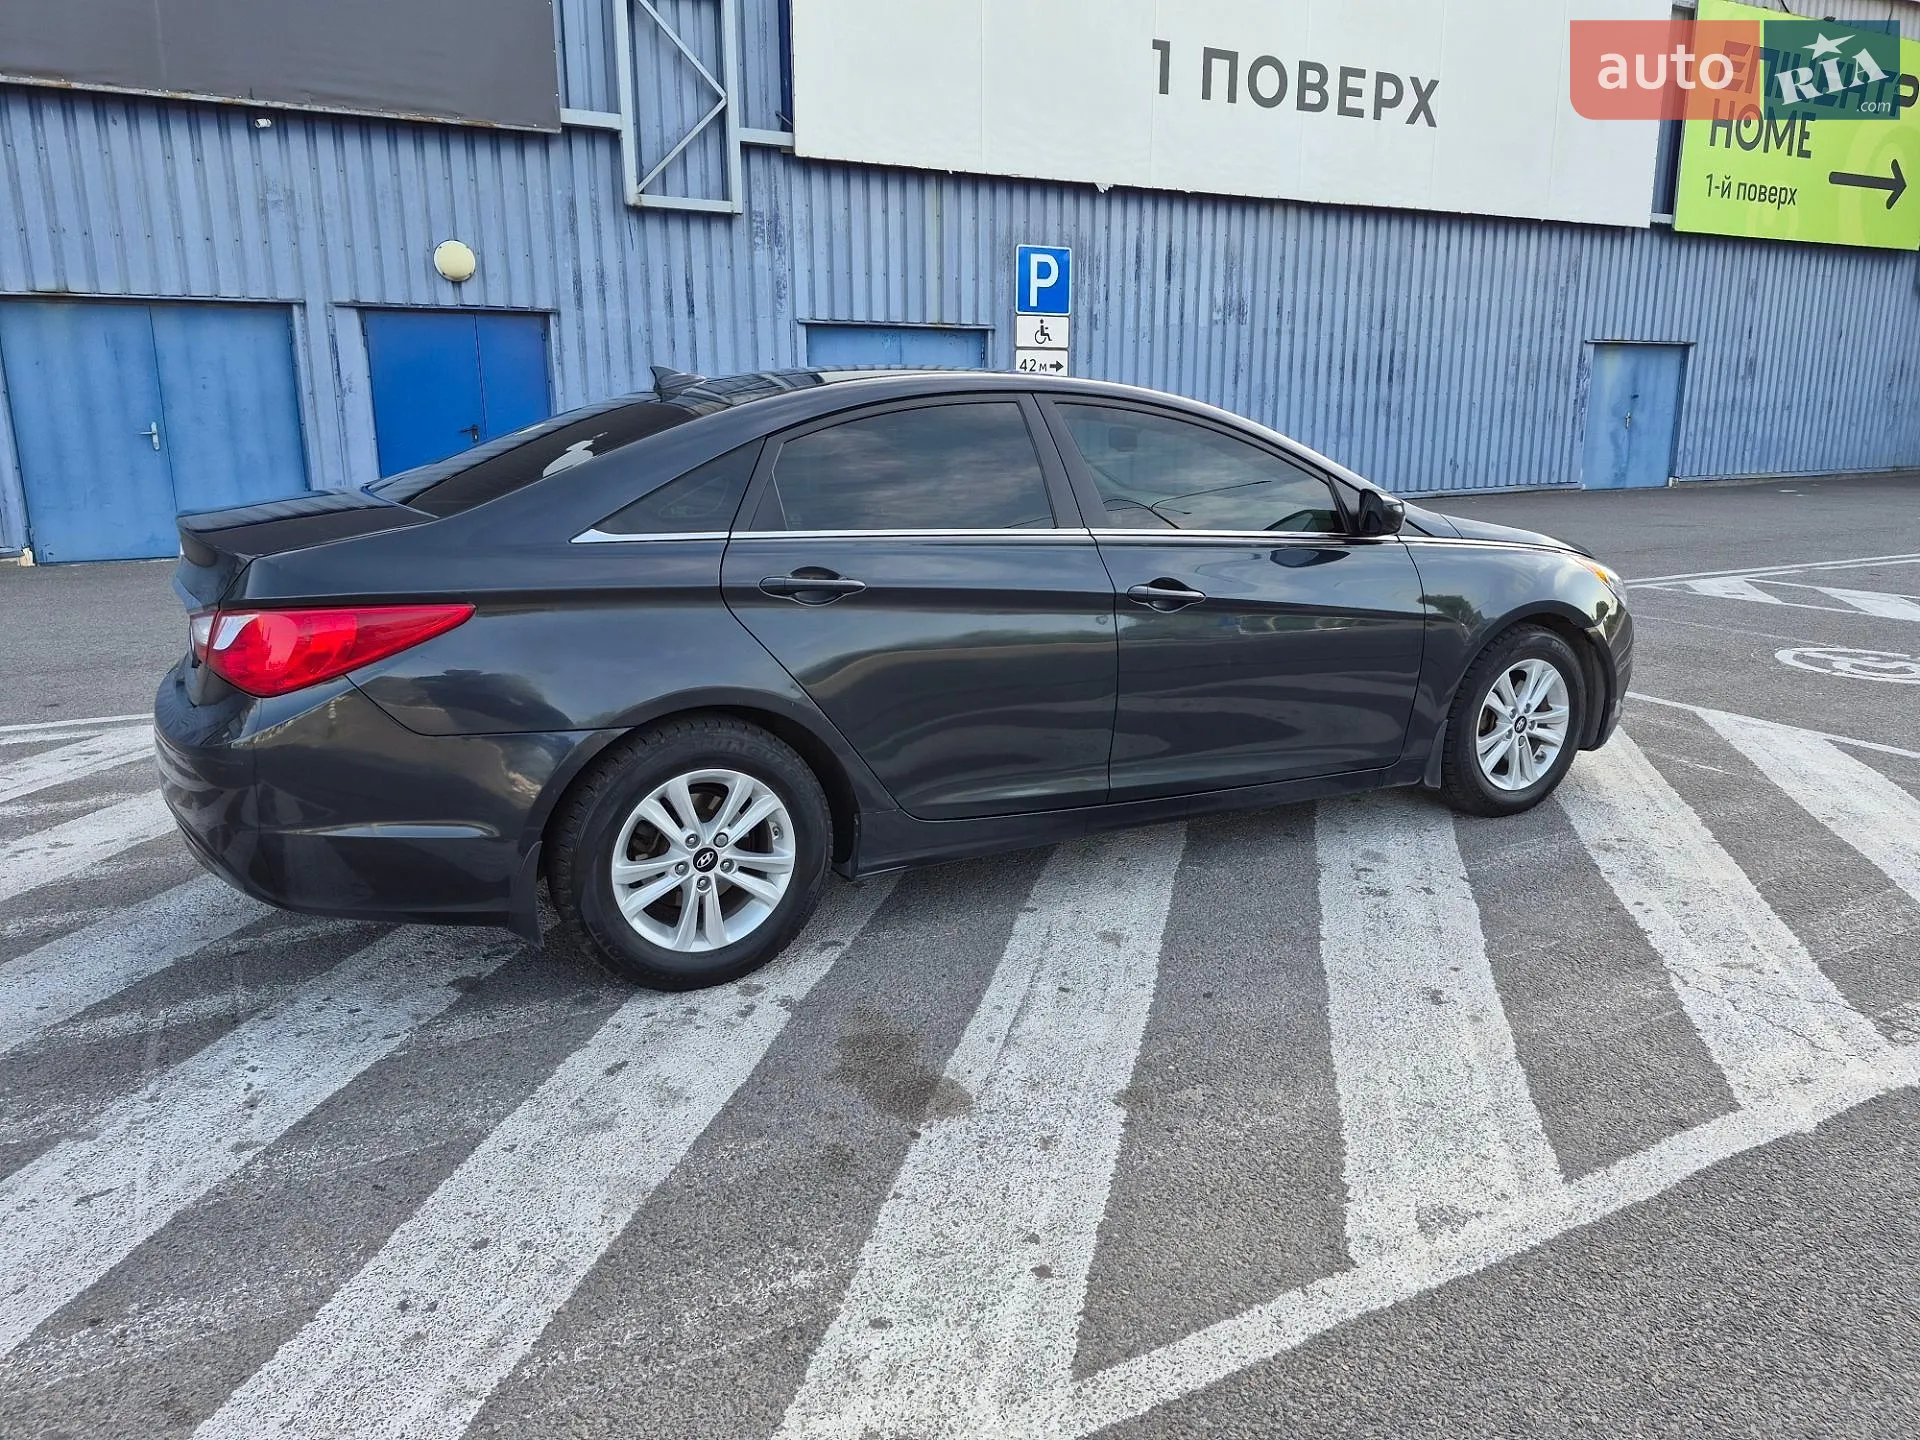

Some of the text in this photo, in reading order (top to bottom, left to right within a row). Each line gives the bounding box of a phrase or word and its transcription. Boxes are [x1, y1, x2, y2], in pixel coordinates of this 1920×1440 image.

[1152, 38, 1440, 128] 1 ПОВЕРХ
[1708, 98, 1817, 159] HOME
[1706, 173, 1798, 211] 1-й поверх
[1029, 253, 1059, 307] P
